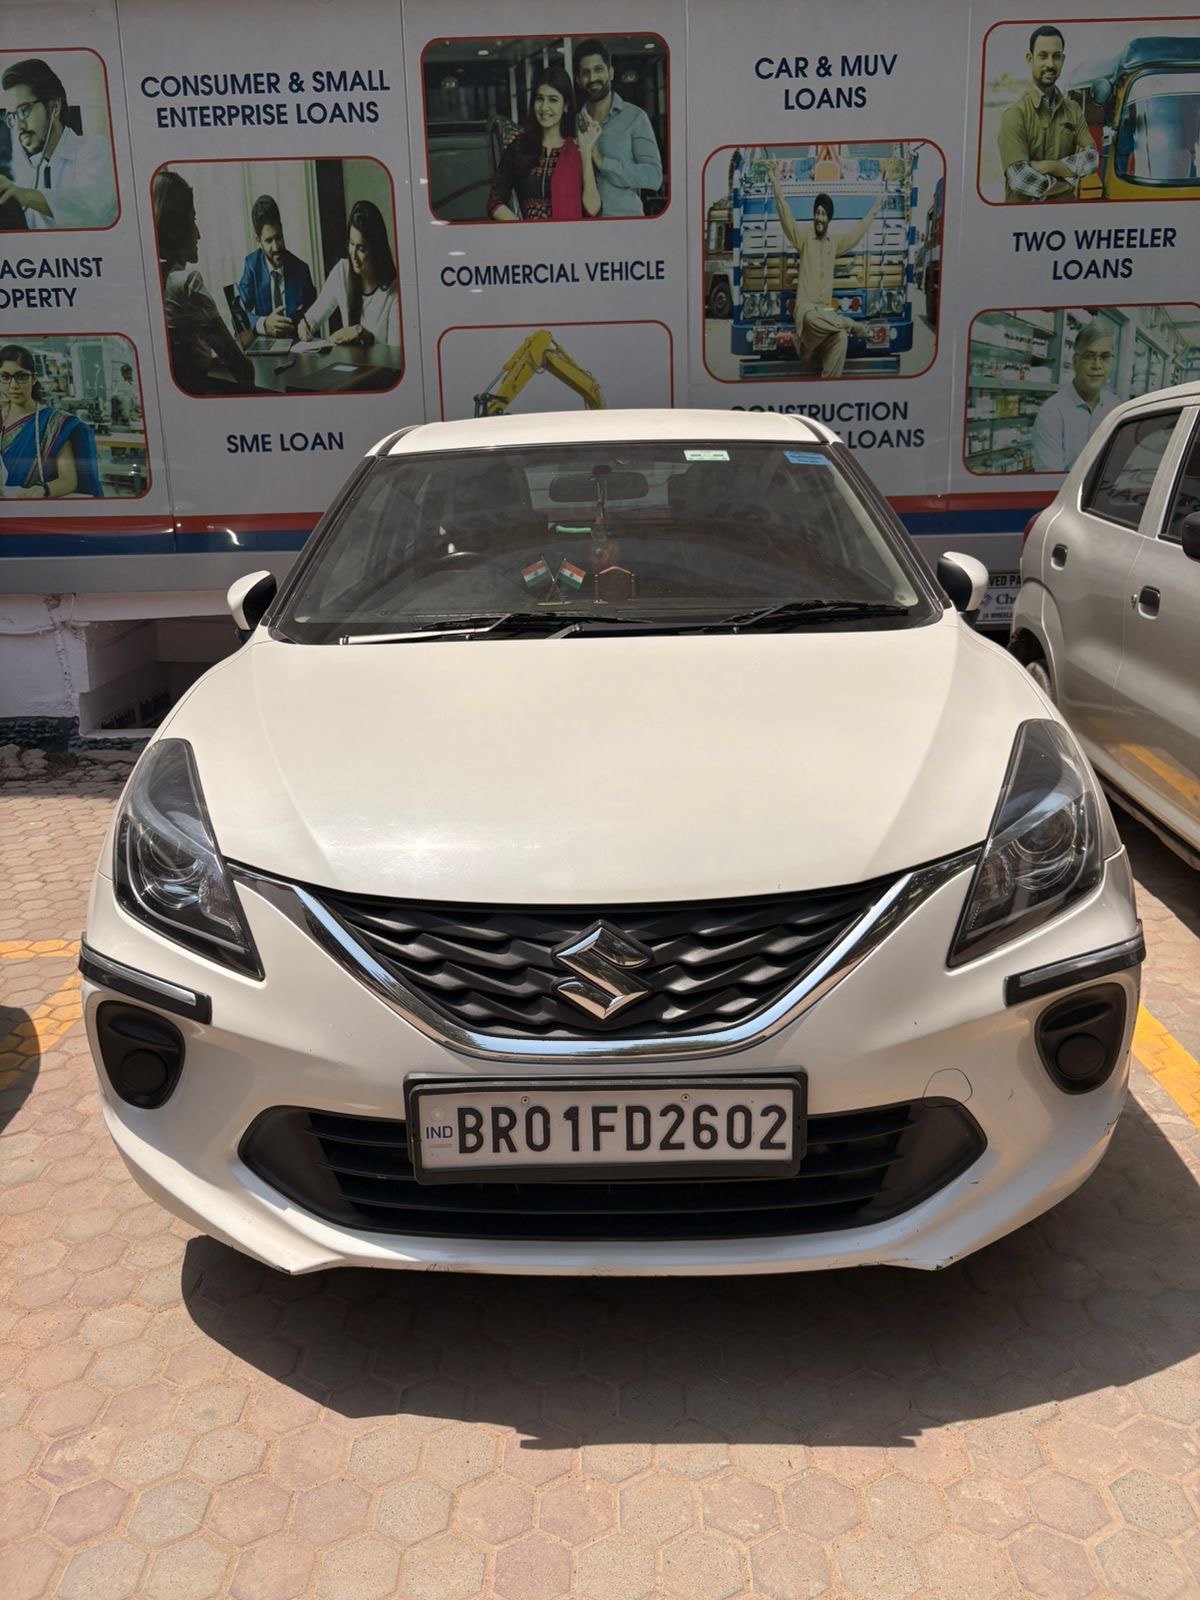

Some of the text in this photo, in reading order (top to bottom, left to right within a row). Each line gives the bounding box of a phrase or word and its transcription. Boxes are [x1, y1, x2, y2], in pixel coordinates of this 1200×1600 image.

[755, 54, 899, 79] CAR & MUV
[141, 70, 391, 98] CONSUMER & SMALL
[784, 86, 867, 110] LOANS
[156, 101, 380, 128] ENTERPRISE LOANS
[1013, 228, 1177, 252] TWO WHEELER
[0, 257, 103, 279] AGAINST
[441, 260, 665, 287] COMMERCIAL VEHICLE
[1052, 258, 1134, 280] LOANS
[227, 432, 345, 453] SME LOAN
[847, 429, 925, 449] LOANS
[426, 1104, 788, 1154] IND BR01FD2602
